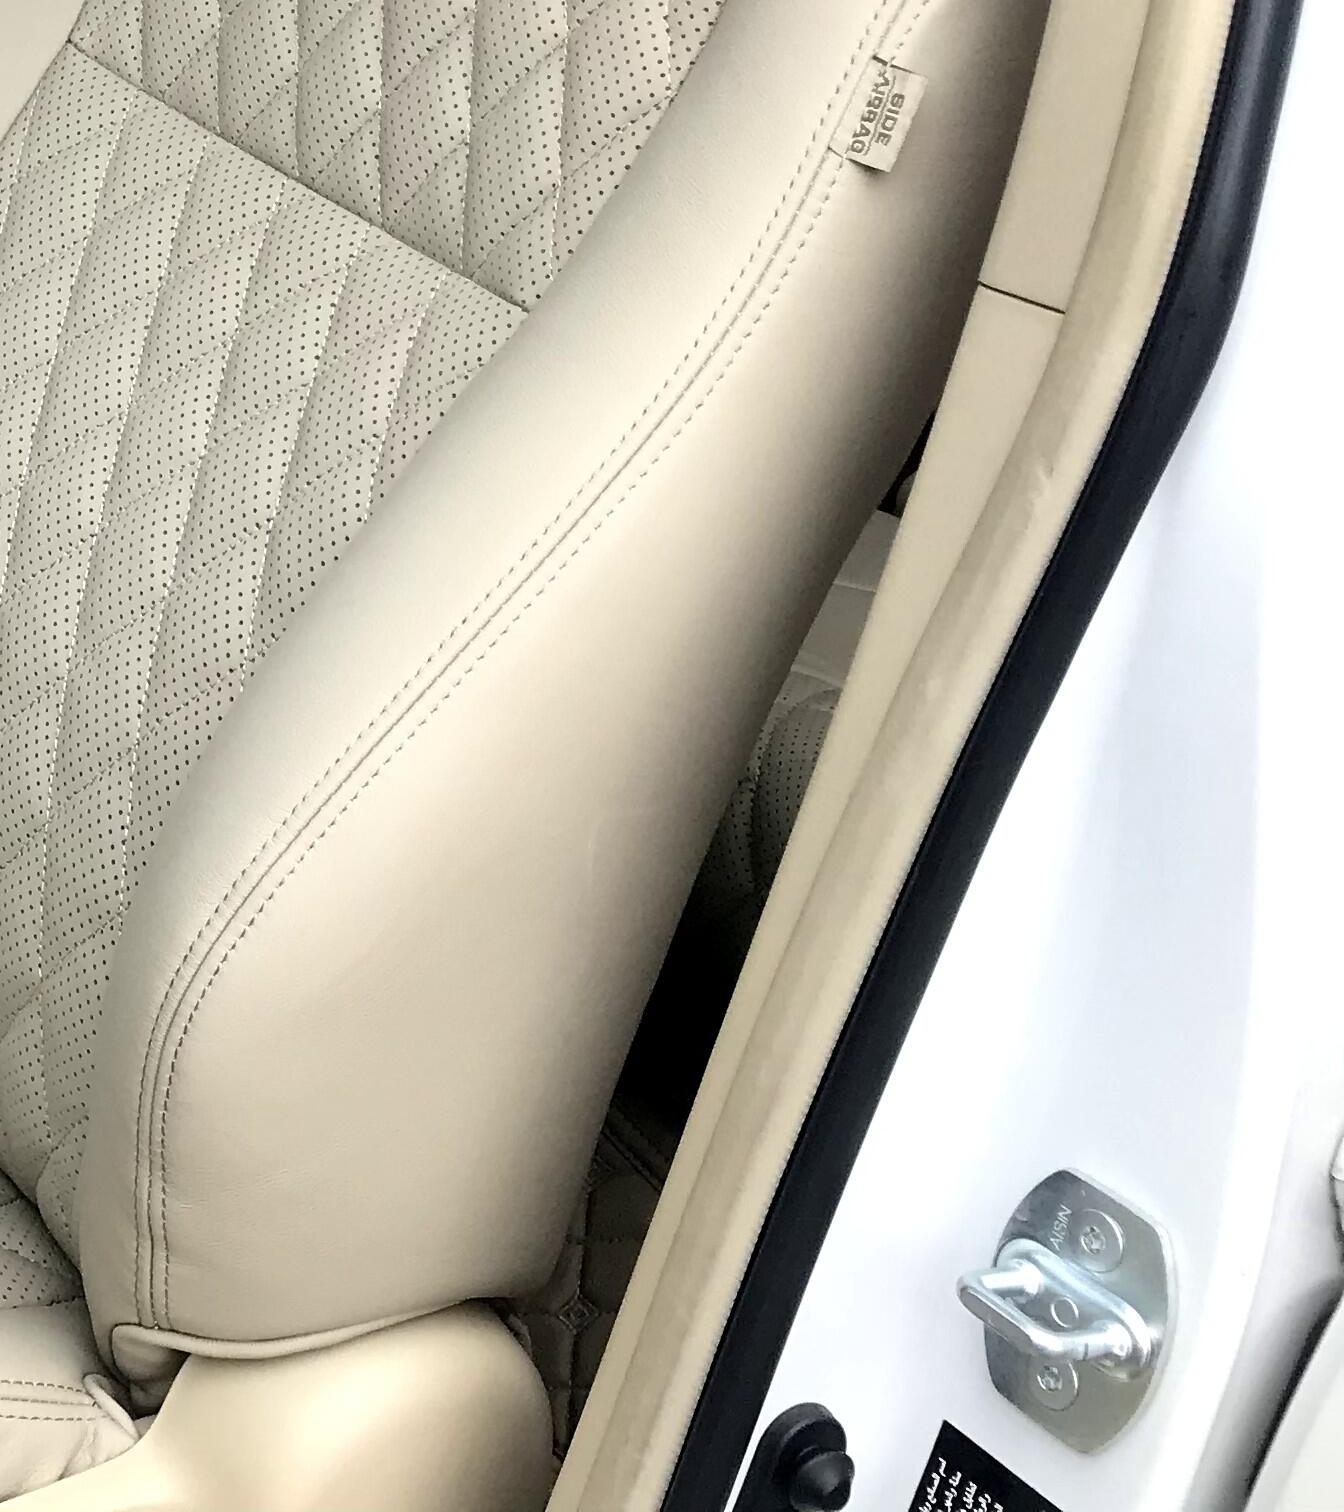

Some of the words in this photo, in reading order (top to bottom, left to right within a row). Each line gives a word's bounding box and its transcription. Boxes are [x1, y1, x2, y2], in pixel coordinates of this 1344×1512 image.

[851, 69, 890, 154] AIRBAG
[874, 92, 905, 146] SIDE
[1049, 1202, 1072, 1252] AISIN
